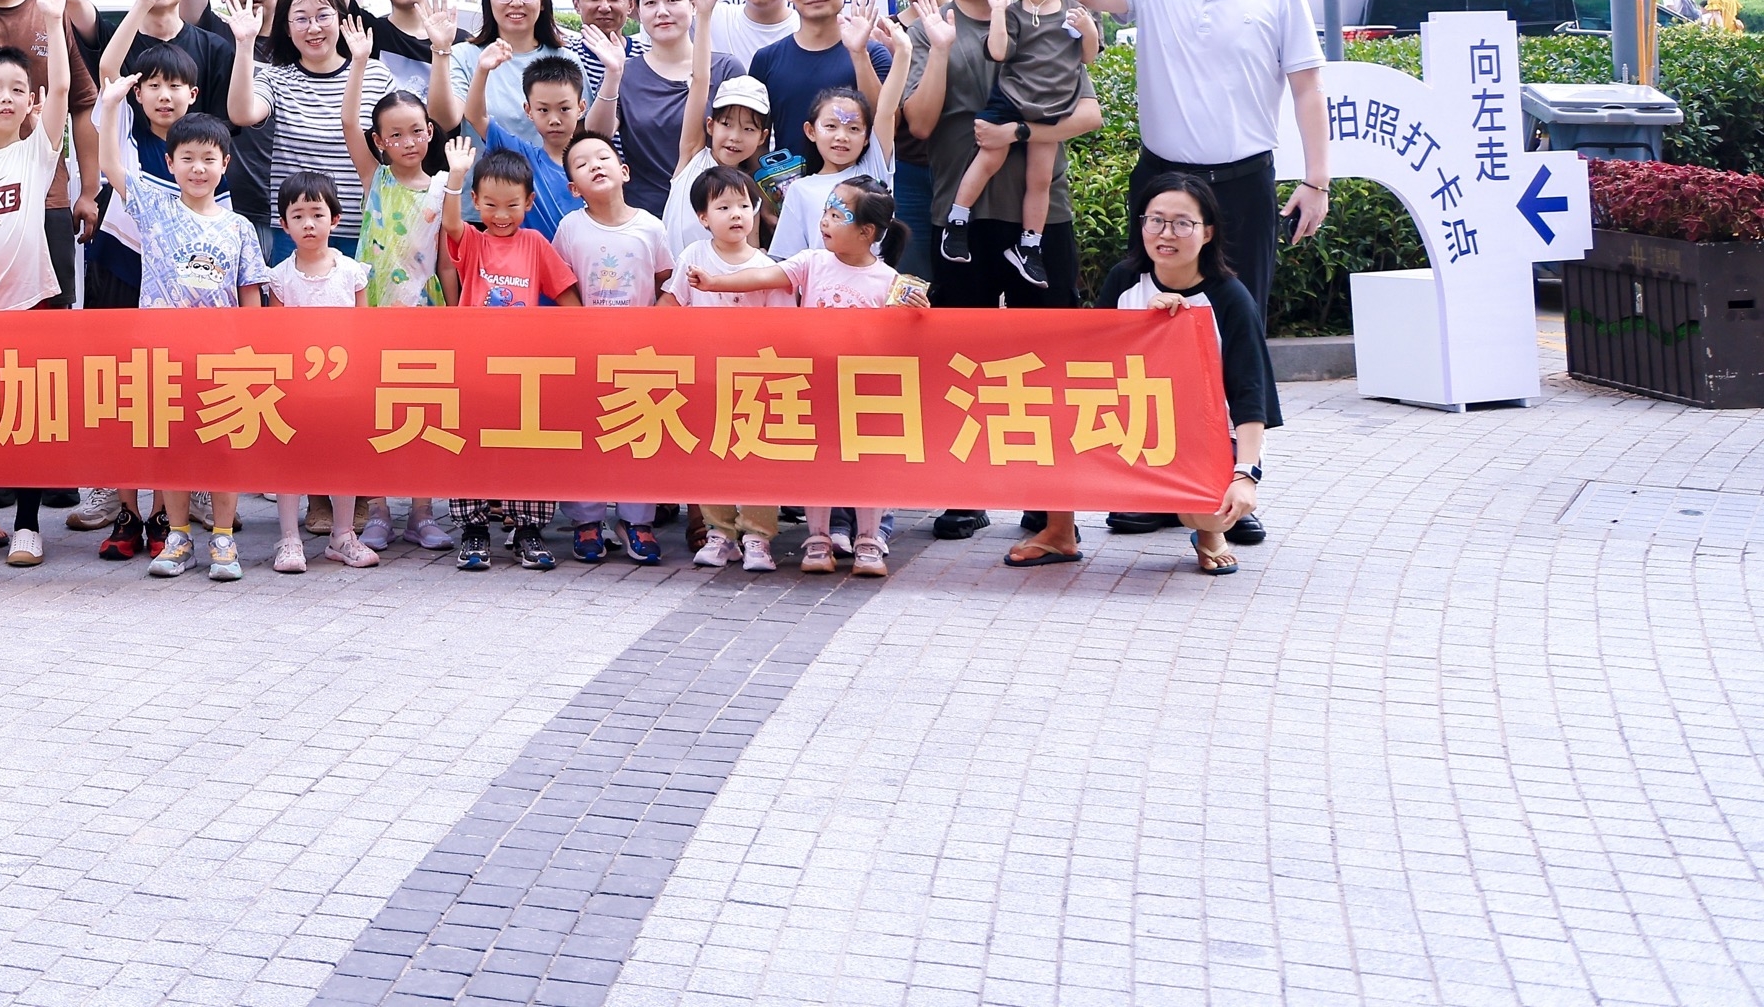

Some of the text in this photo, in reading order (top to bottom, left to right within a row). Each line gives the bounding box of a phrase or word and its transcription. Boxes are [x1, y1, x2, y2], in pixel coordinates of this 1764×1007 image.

[1327, 94, 1481, 265] 拍照打卡点
[1469, 38, 1511, 183] 向左走
[173, 242, 231, 270] SKECHERS
